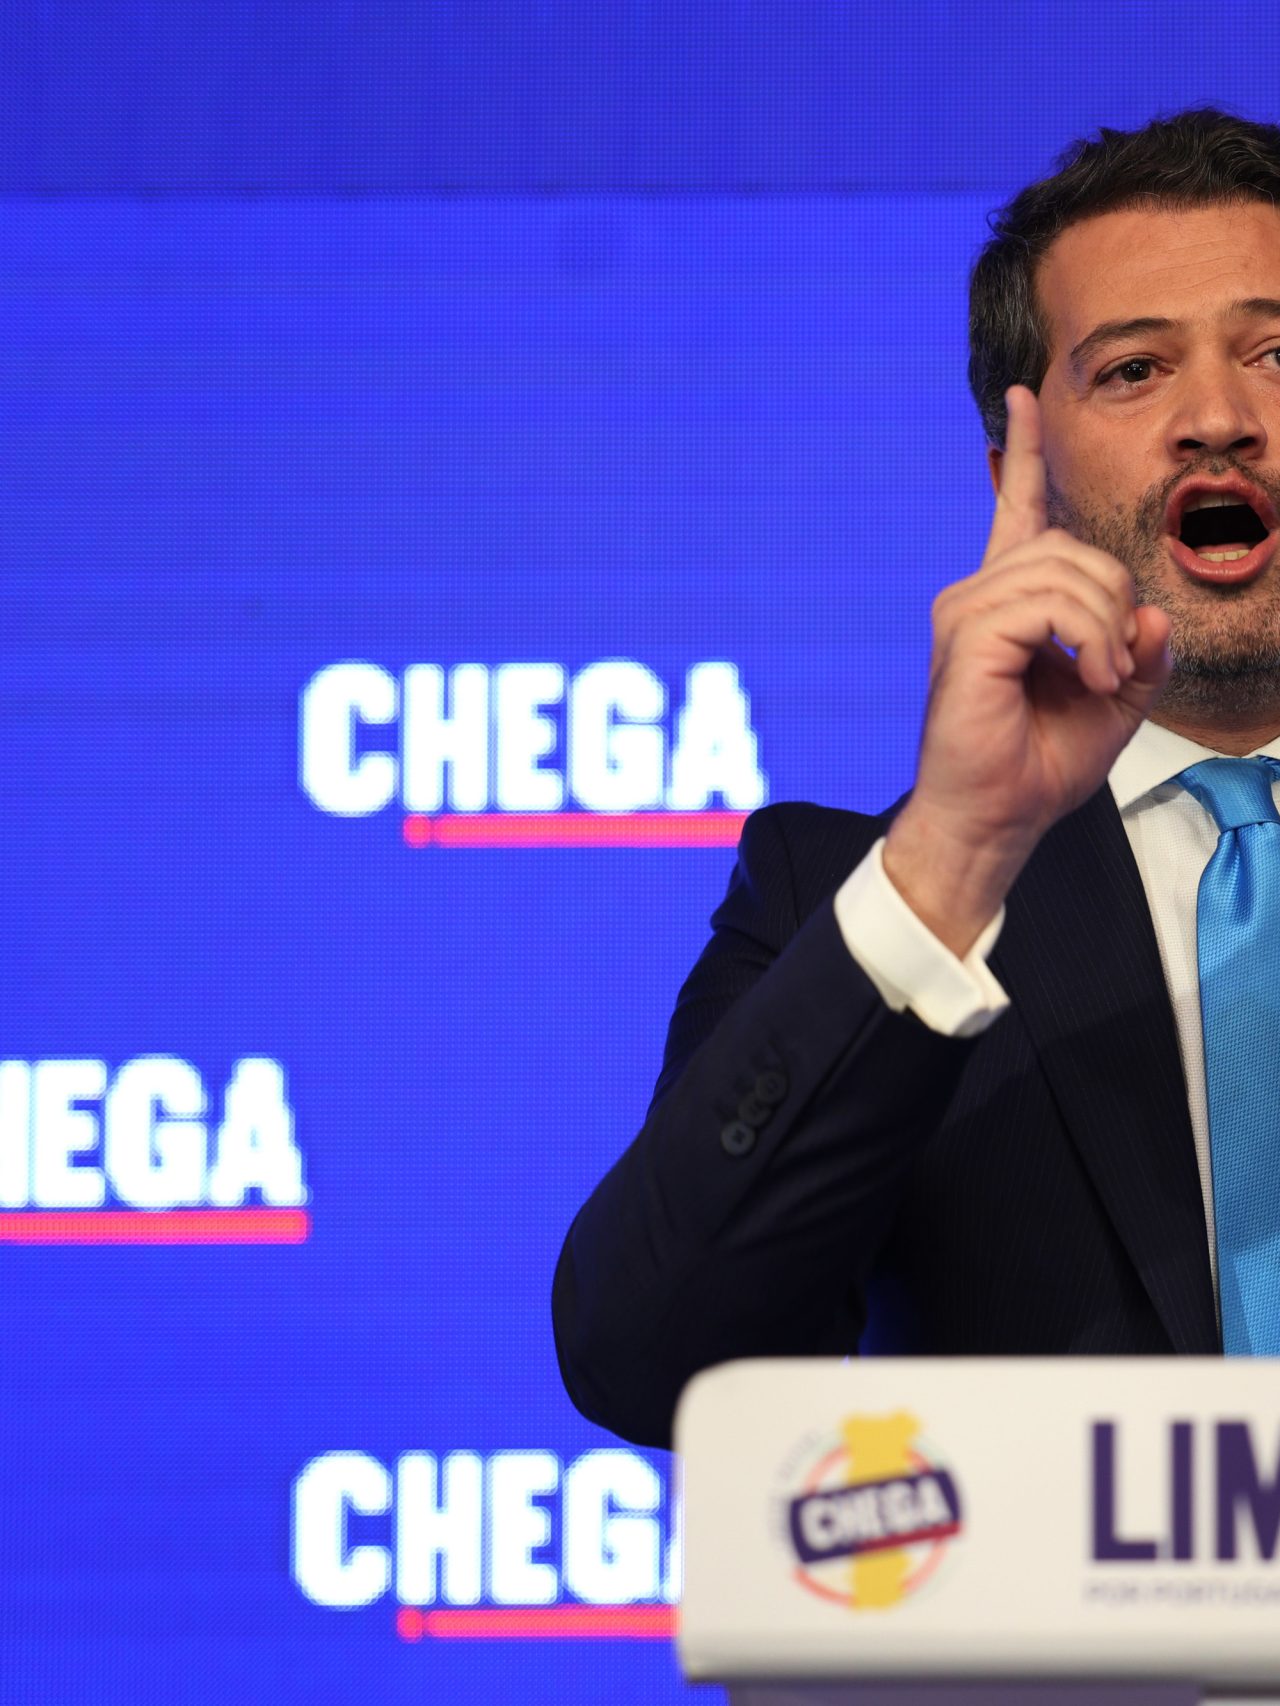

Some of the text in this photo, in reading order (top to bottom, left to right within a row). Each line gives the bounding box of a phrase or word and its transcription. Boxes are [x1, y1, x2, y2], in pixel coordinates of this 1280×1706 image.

[300, 658, 769, 818] CHEGA
[293, 1447, 685, 1610] CHEG
[798, 1474, 955, 1553] CHEGA
